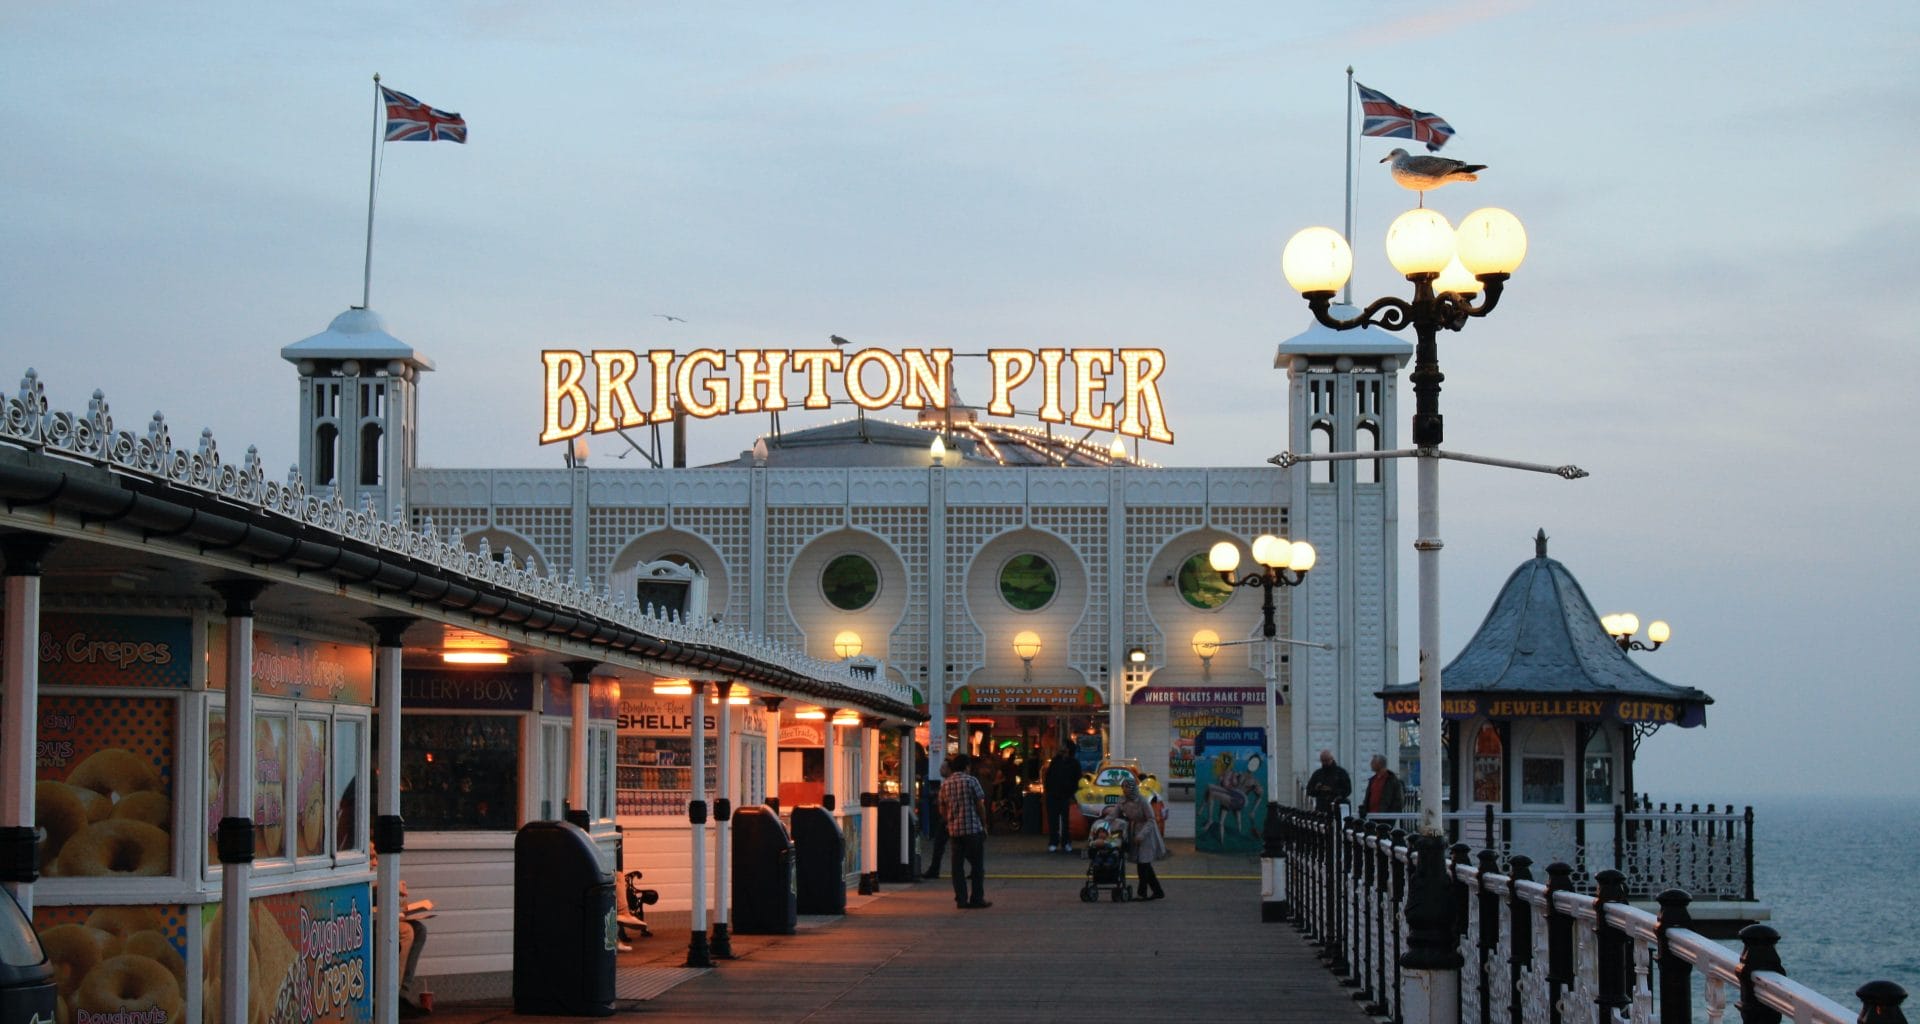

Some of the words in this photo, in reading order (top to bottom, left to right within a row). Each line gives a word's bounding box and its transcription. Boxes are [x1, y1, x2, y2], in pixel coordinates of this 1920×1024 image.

[539, 348, 952, 445] BRIGHTON
[987, 347, 1174, 445] PIER
[39, 631, 62, 662] &
[67, 632, 171, 669] Crepes
[1145, 691, 1174, 702] WHERE
[1177, 691, 1211, 703] TICKETS
[1214, 691, 1238, 702] MAKE
[1386, 699, 1477, 714] ACCERIES
[1489, 701, 1603, 716] JEWELLERY
[1619, 701, 1674, 721] GIFTS
[617, 715, 715, 729] SHELLFS
[1172, 717, 1239, 728] REDEMPTION
[1206, 731, 1241, 741] BRIGHTON
[1243, 731, 1259, 740] PIER
[301, 898, 363, 964] Doughnuts
[301, 959, 313, 1022] &
[314, 957, 365, 1018] Crepes
